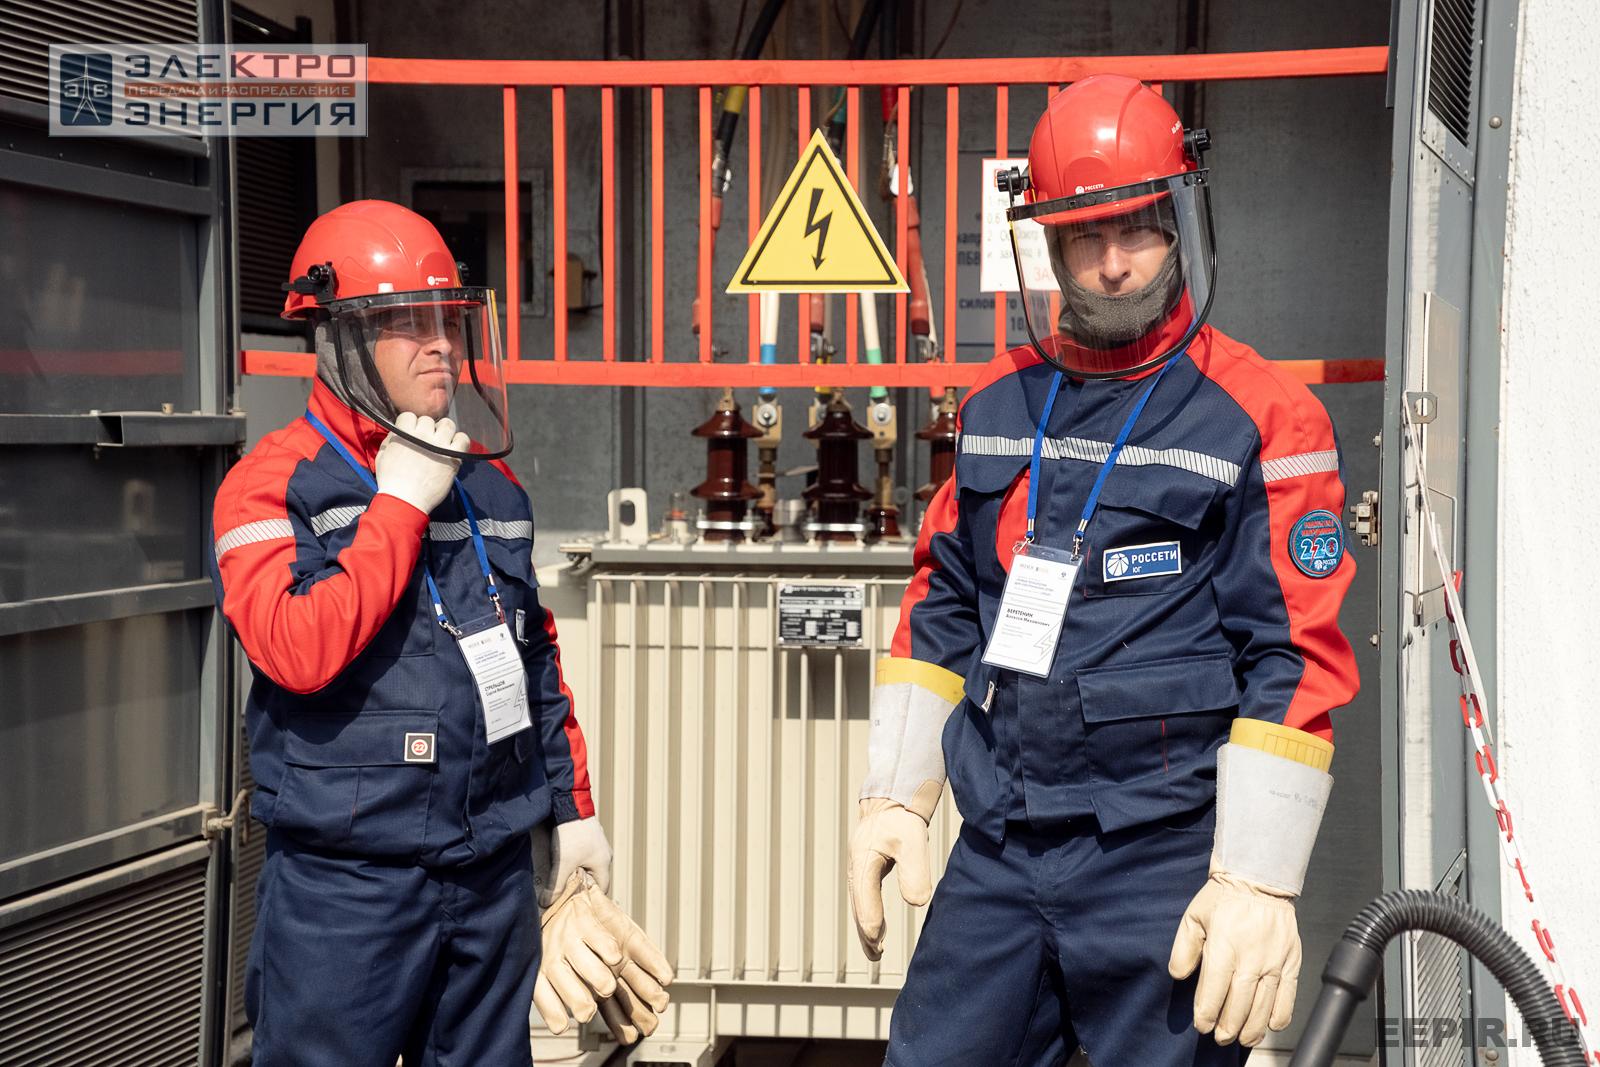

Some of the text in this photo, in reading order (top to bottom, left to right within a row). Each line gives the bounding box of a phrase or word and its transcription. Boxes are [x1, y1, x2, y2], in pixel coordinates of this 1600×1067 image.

[1300, 537, 1339, 560] 220
[1131, 550, 1177, 564] РОССЕТИ
[1132, 566, 1142, 574] ЮГ
